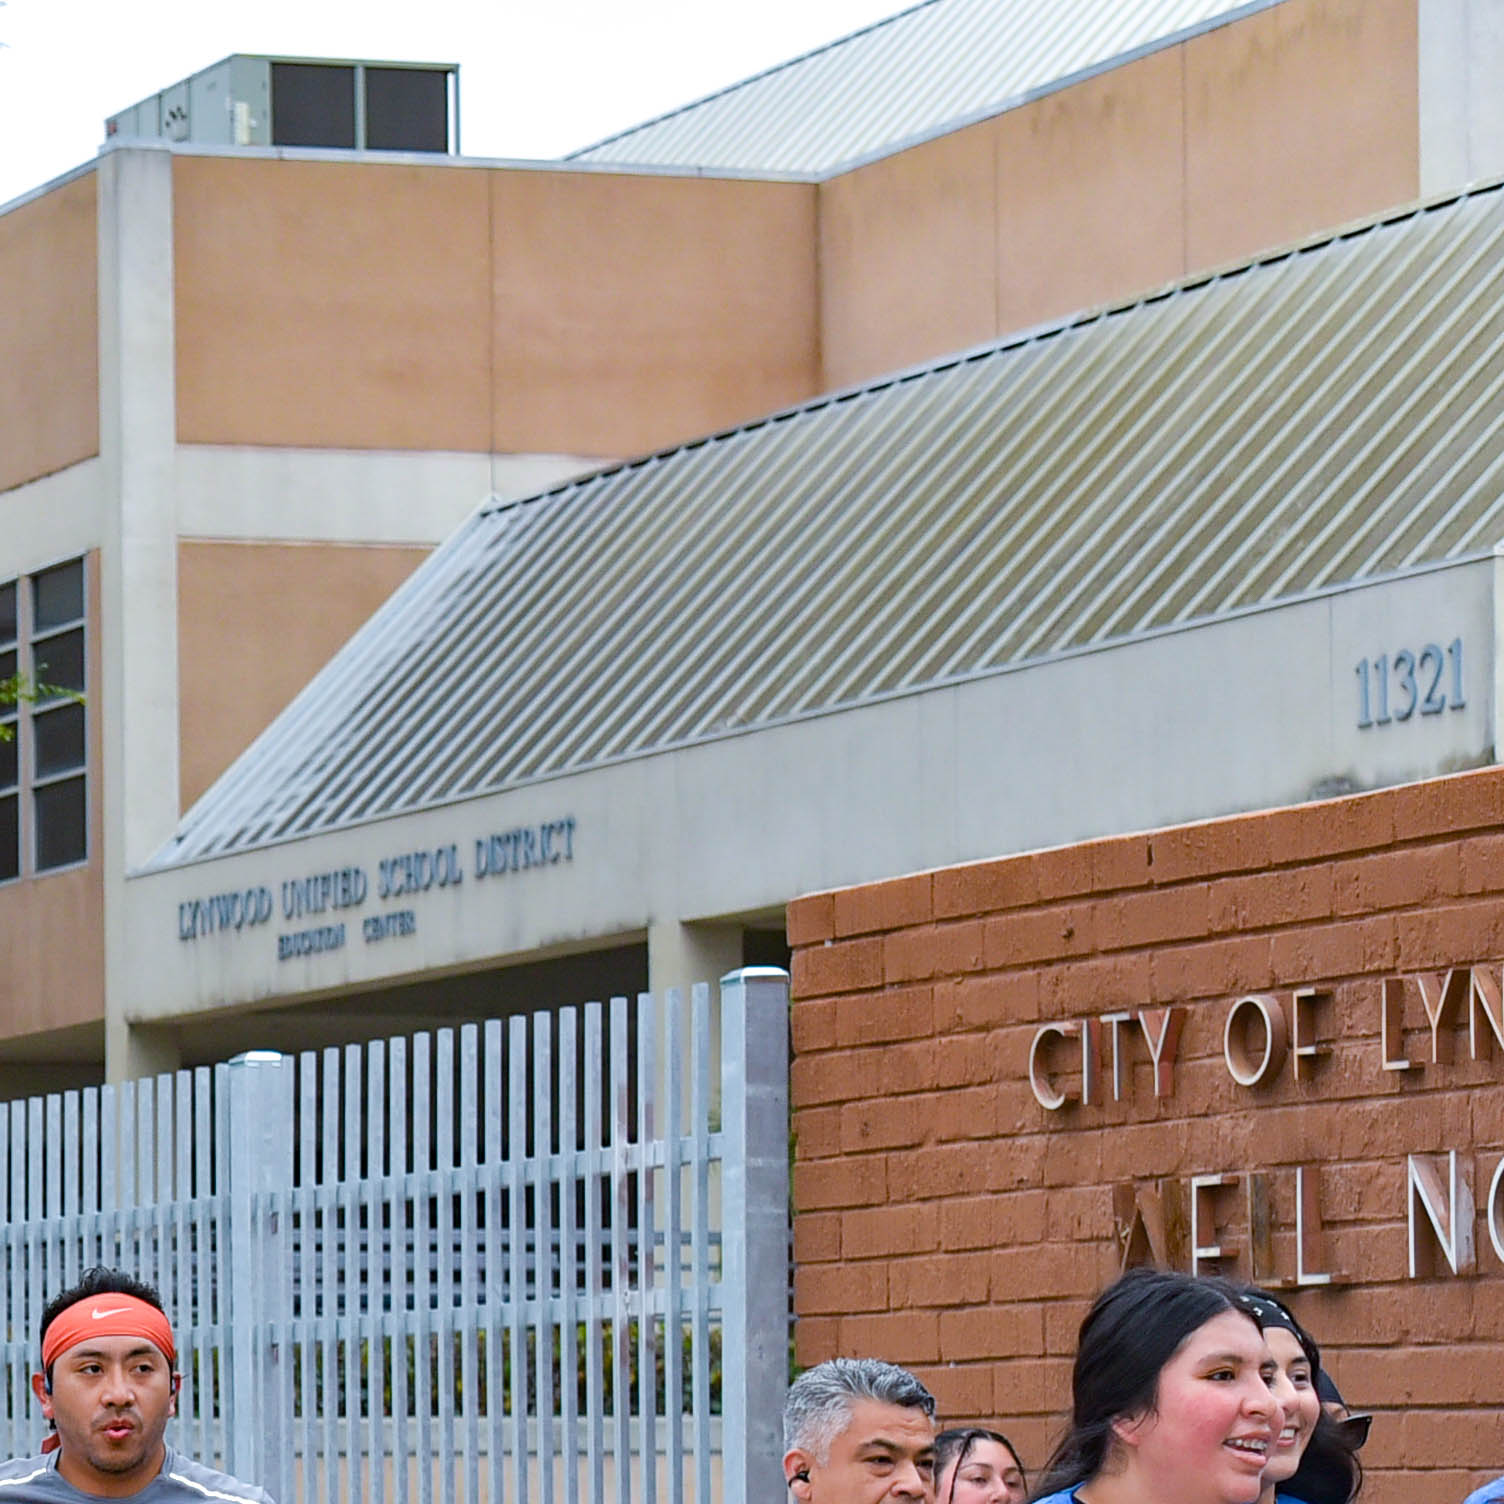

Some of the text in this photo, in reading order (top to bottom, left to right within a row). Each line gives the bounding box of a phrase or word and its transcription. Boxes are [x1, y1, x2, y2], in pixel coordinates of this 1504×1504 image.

[1355, 637, 1467, 731] 11321
[178, 815, 578, 941] LYNWOOD UNIFIED SCHOOL DISTRICT
[278, 909, 417, 962] EDUCATION CENTER
[1029, 1006, 1182, 1110] CITY
[1224, 987, 1326, 1087] OF
[1408, 1149, 1504, 1279] N
